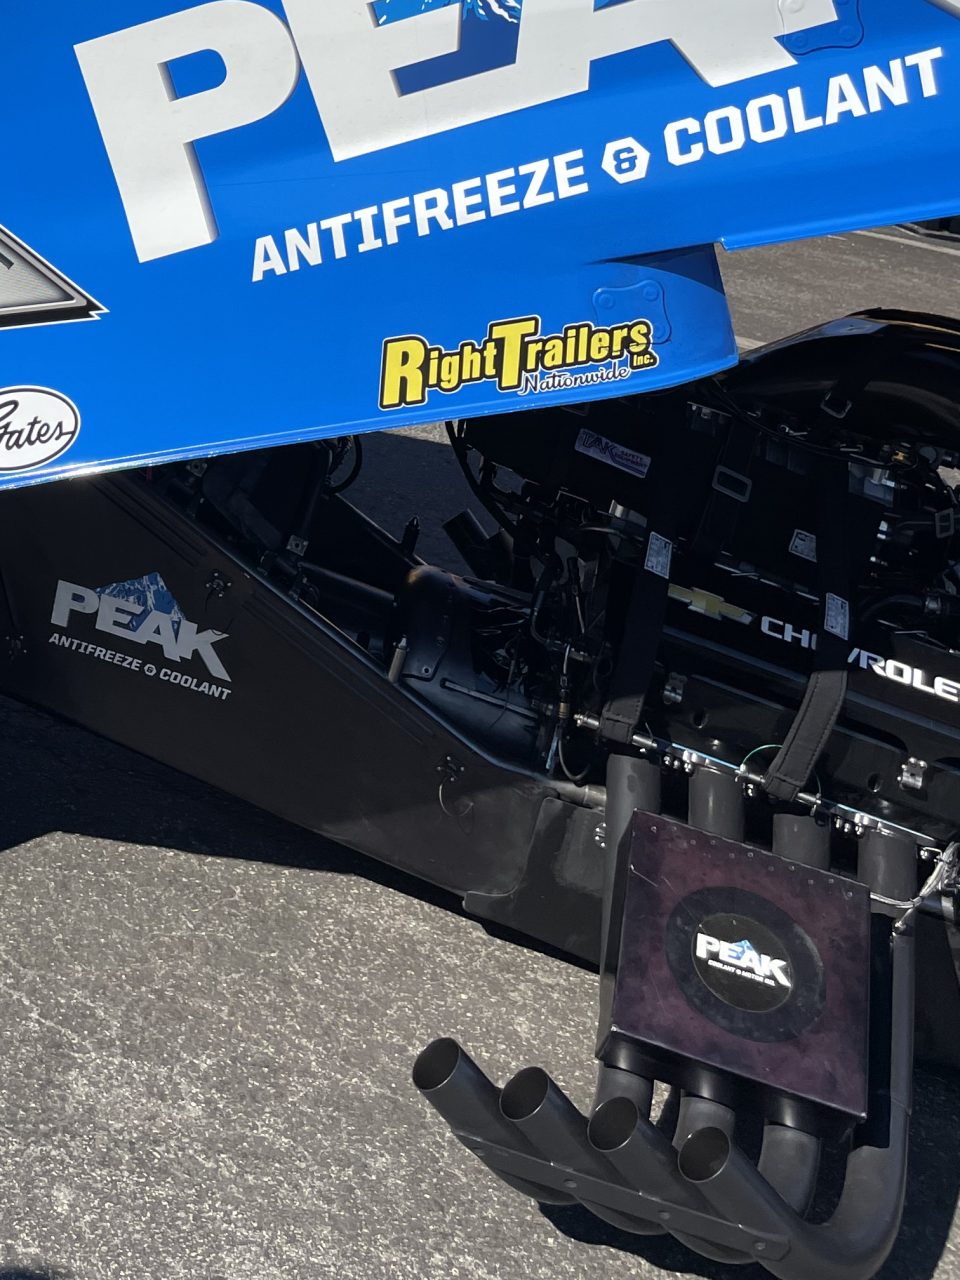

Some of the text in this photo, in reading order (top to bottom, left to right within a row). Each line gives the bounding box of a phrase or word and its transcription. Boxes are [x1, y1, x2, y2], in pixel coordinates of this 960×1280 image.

[252, 46, 944, 282] ANTIFREEZE & COOLANT
[519, 363, 631, 396] Nationwide
[632, 351, 655, 368] Inc.
[50, 579, 232, 683] PEAK
[48, 633, 142, 671] ANTIFREEZE
[159, 668, 232, 701] COOLANT
[696, 932, 792, 988] PEAK
[707, 959, 736, 974] COOLANT
